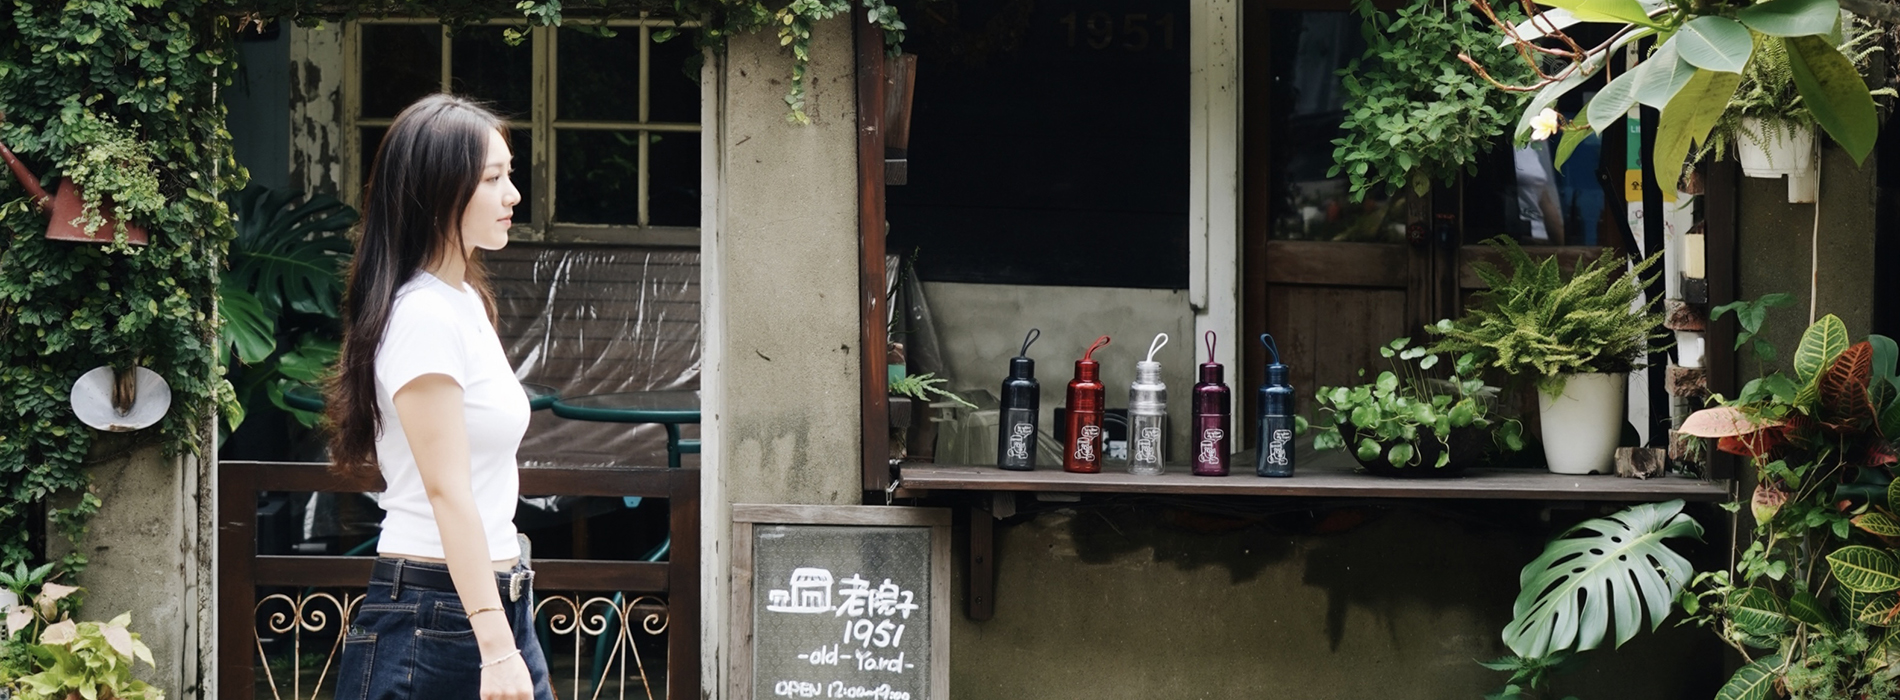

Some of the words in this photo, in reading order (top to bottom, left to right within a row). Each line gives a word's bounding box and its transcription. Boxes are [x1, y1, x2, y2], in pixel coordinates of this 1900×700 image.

[1060, 10, 1174, 51] 1951
[835, 573, 918, 619] 老院子
[843, 619, 905, 648] 1951
[775, 680, 821, 698] OPEN
